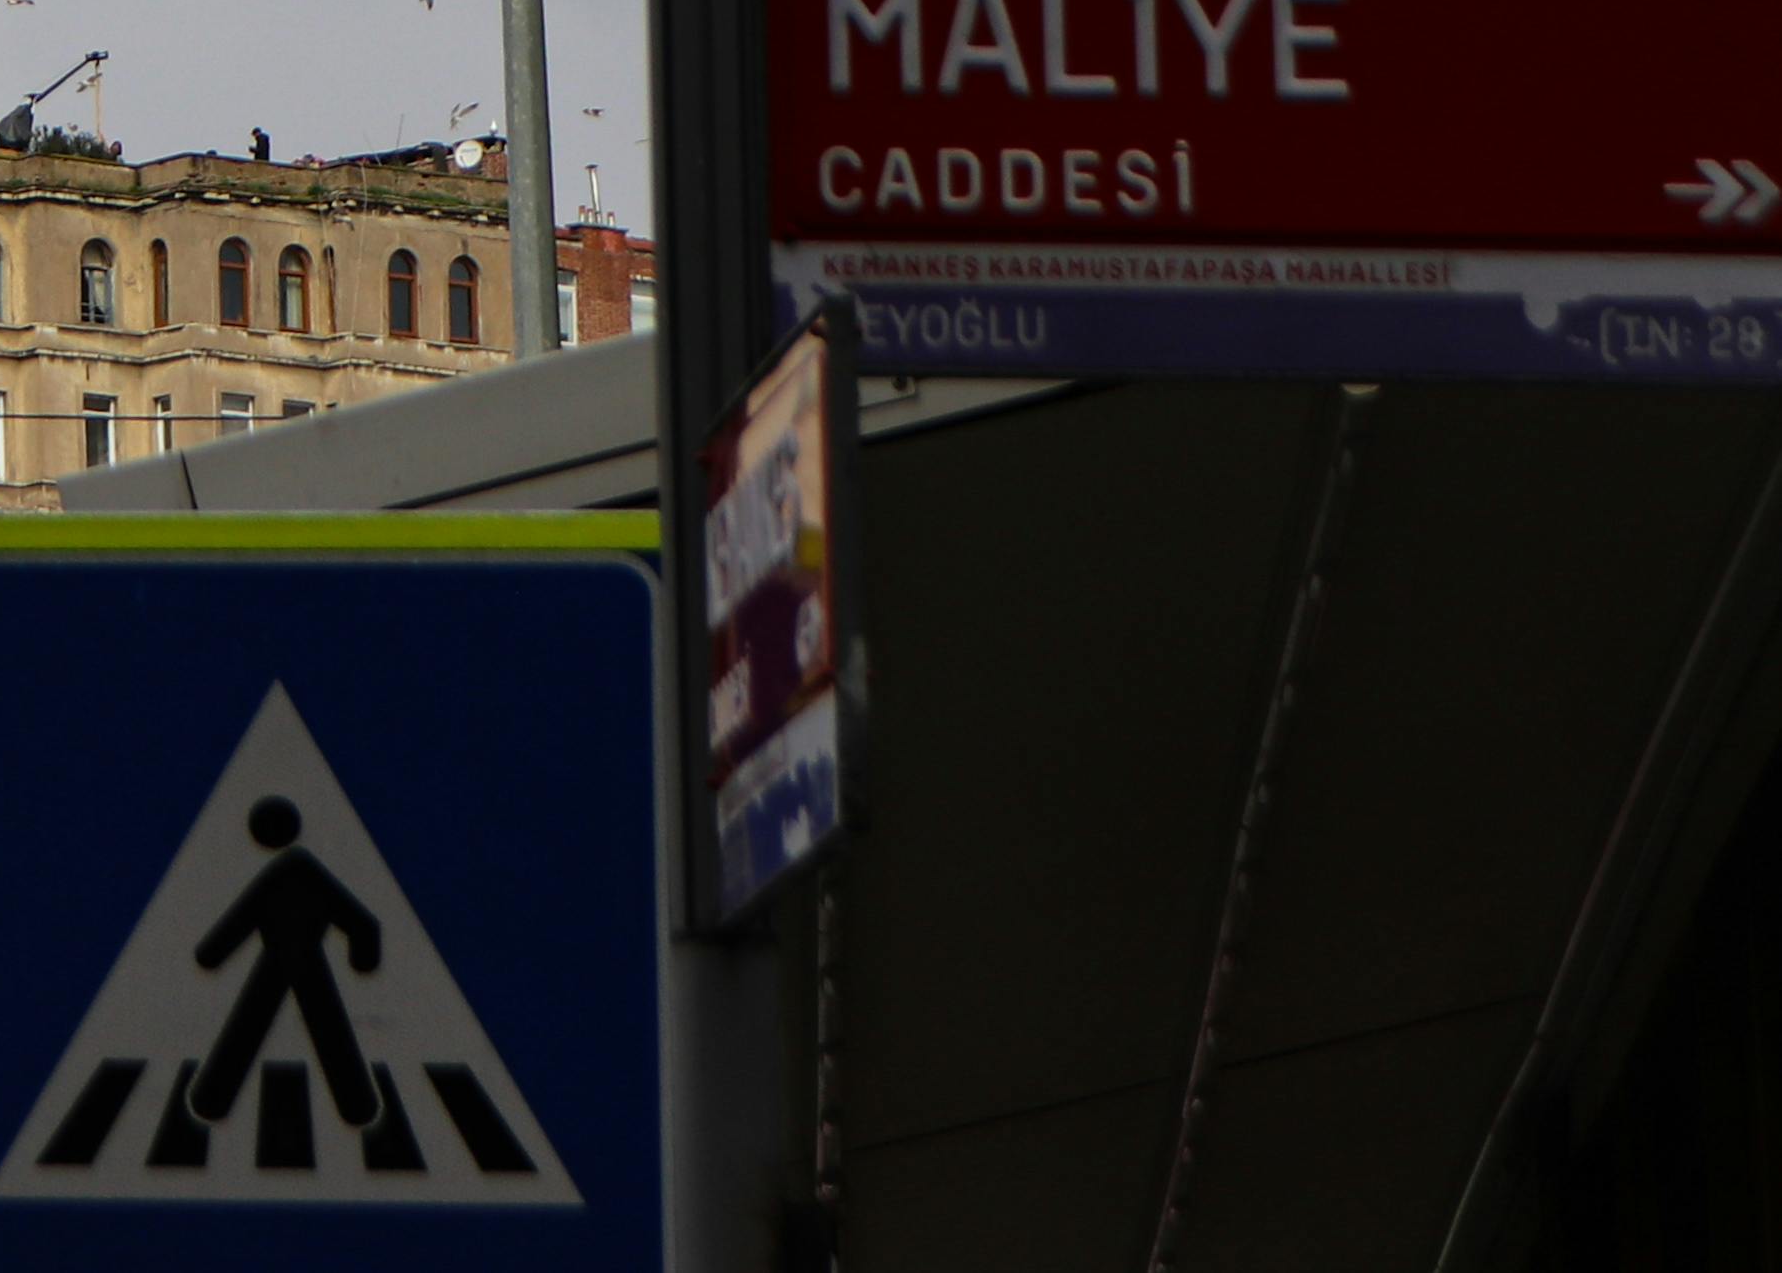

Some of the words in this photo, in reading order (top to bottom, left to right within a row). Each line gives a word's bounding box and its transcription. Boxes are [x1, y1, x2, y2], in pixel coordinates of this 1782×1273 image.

[818, 140, 1196, 217] CADDESİ
[822, 253, 980, 282] KEMANKEŞ
[988, 254, 1277, 285] KARAMUSTAFAPAŞA
[1285, 257, 1452, 286] MAHALLESİ
[856, 297, 1047, 349] EYOĞLU
